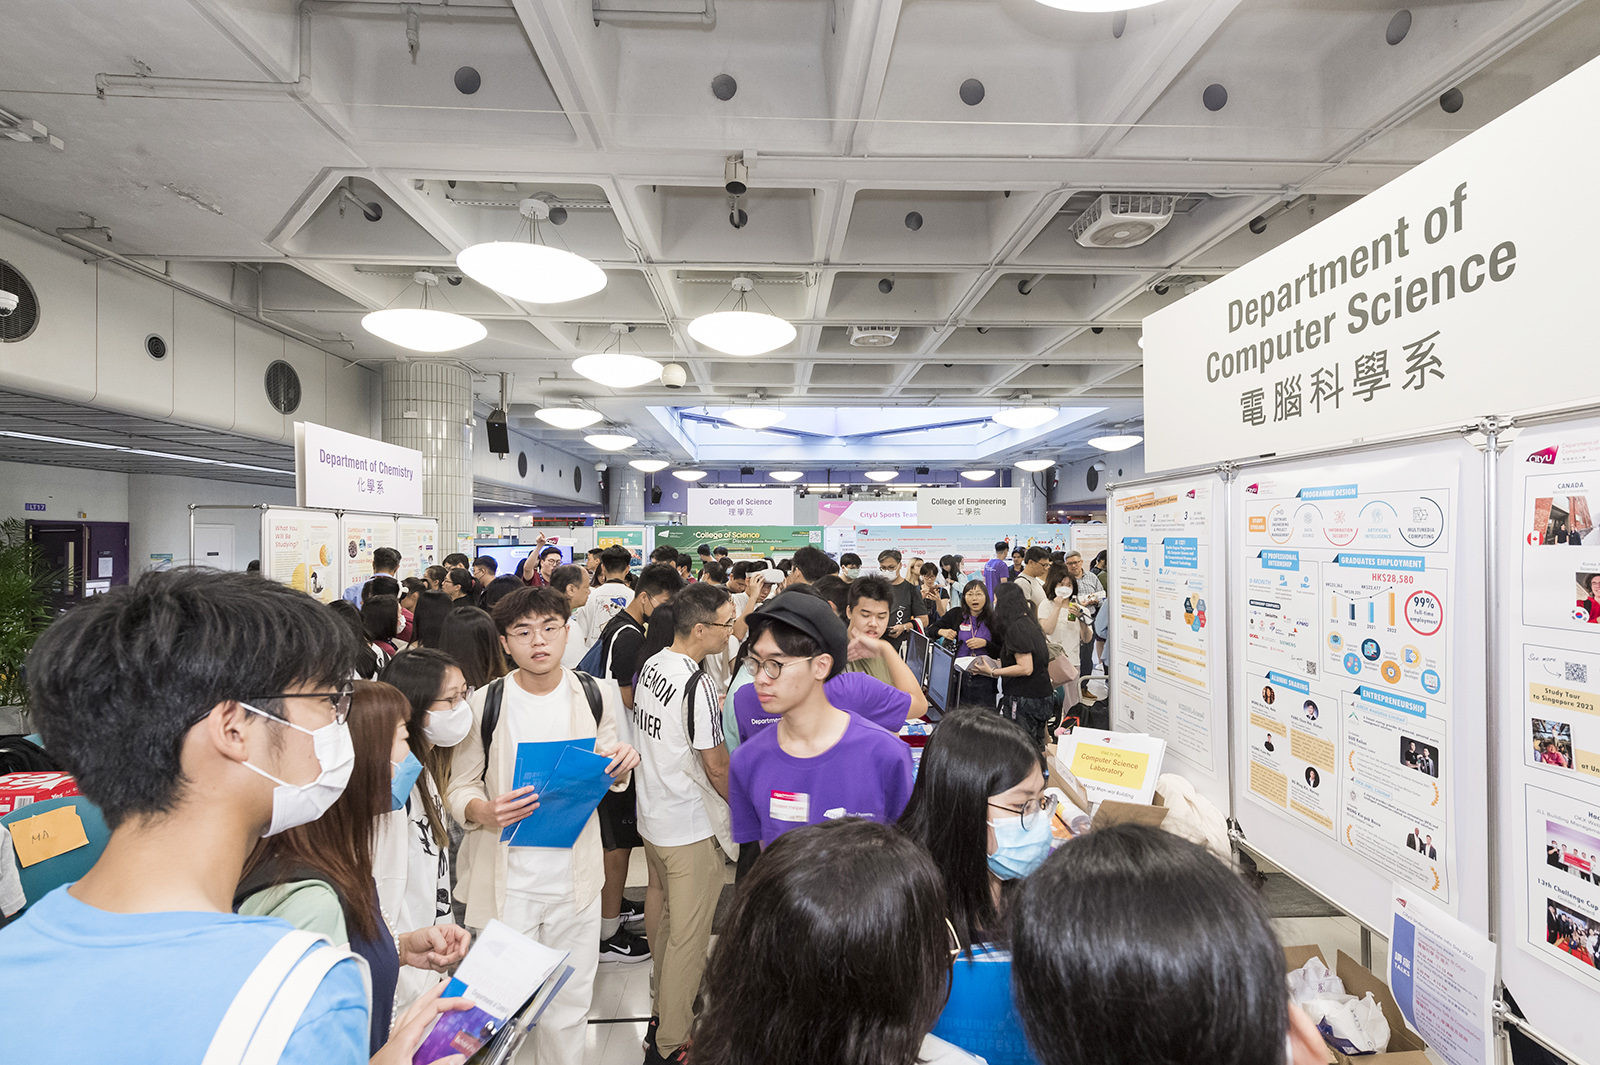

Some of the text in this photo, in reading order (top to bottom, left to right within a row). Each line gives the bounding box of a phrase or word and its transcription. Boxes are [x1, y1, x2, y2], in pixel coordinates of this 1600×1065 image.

[1228, 181, 1468, 334] Department of
[1206, 240, 1517, 383] Computer Science
[1239, 330, 1446, 427] 電腦科學系
[319, 448, 414, 481] Department of Chemistry
[357, 477, 385, 495] 化學系
[1302, 488, 1356, 498] PROGRAMME DESIGN
[709, 498, 773, 507] College of Science
[931, 498, 956, 506] College
[966, 498, 1007, 506] Engineering
[728, 508, 754, 516] 理學院
[860, 511, 878, 519] CityU
[879, 511, 901, 519] Sports
[957, 508, 981, 516] 工學院
[695, 531, 760, 539] College of Science
[275, 541, 299, 549] Studying?
[1341, 556, 1422, 568] GRADUATES EMPLOYMENT
[1371, 573, 1414, 585] HK$28,580
[1414, 596, 1435, 609] 99%
[1410, 617, 1438, 625] employment
[1528, 653, 1539, 661] See
[1288, 679, 1309, 692] SHARING
[1544, 687, 1581, 700] Study Tour
[1362, 689, 1425, 713] ENTREPRENEURSHIP
[1541, 695, 1574, 708] Singapore
[1576, 701, 1594, 711] 2023
[1080, 753, 1139, 770] Computer Science
[1089, 764, 1125, 777] Laboratory
[1116, 791, 1135, 799] Building
[1547, 812, 1569, 824] Building
[1537, 878, 1599, 911] 13th Challenge Cup
[1462, 950, 1474, 961] 2023
[1394, 961, 1411, 978] TALKS
